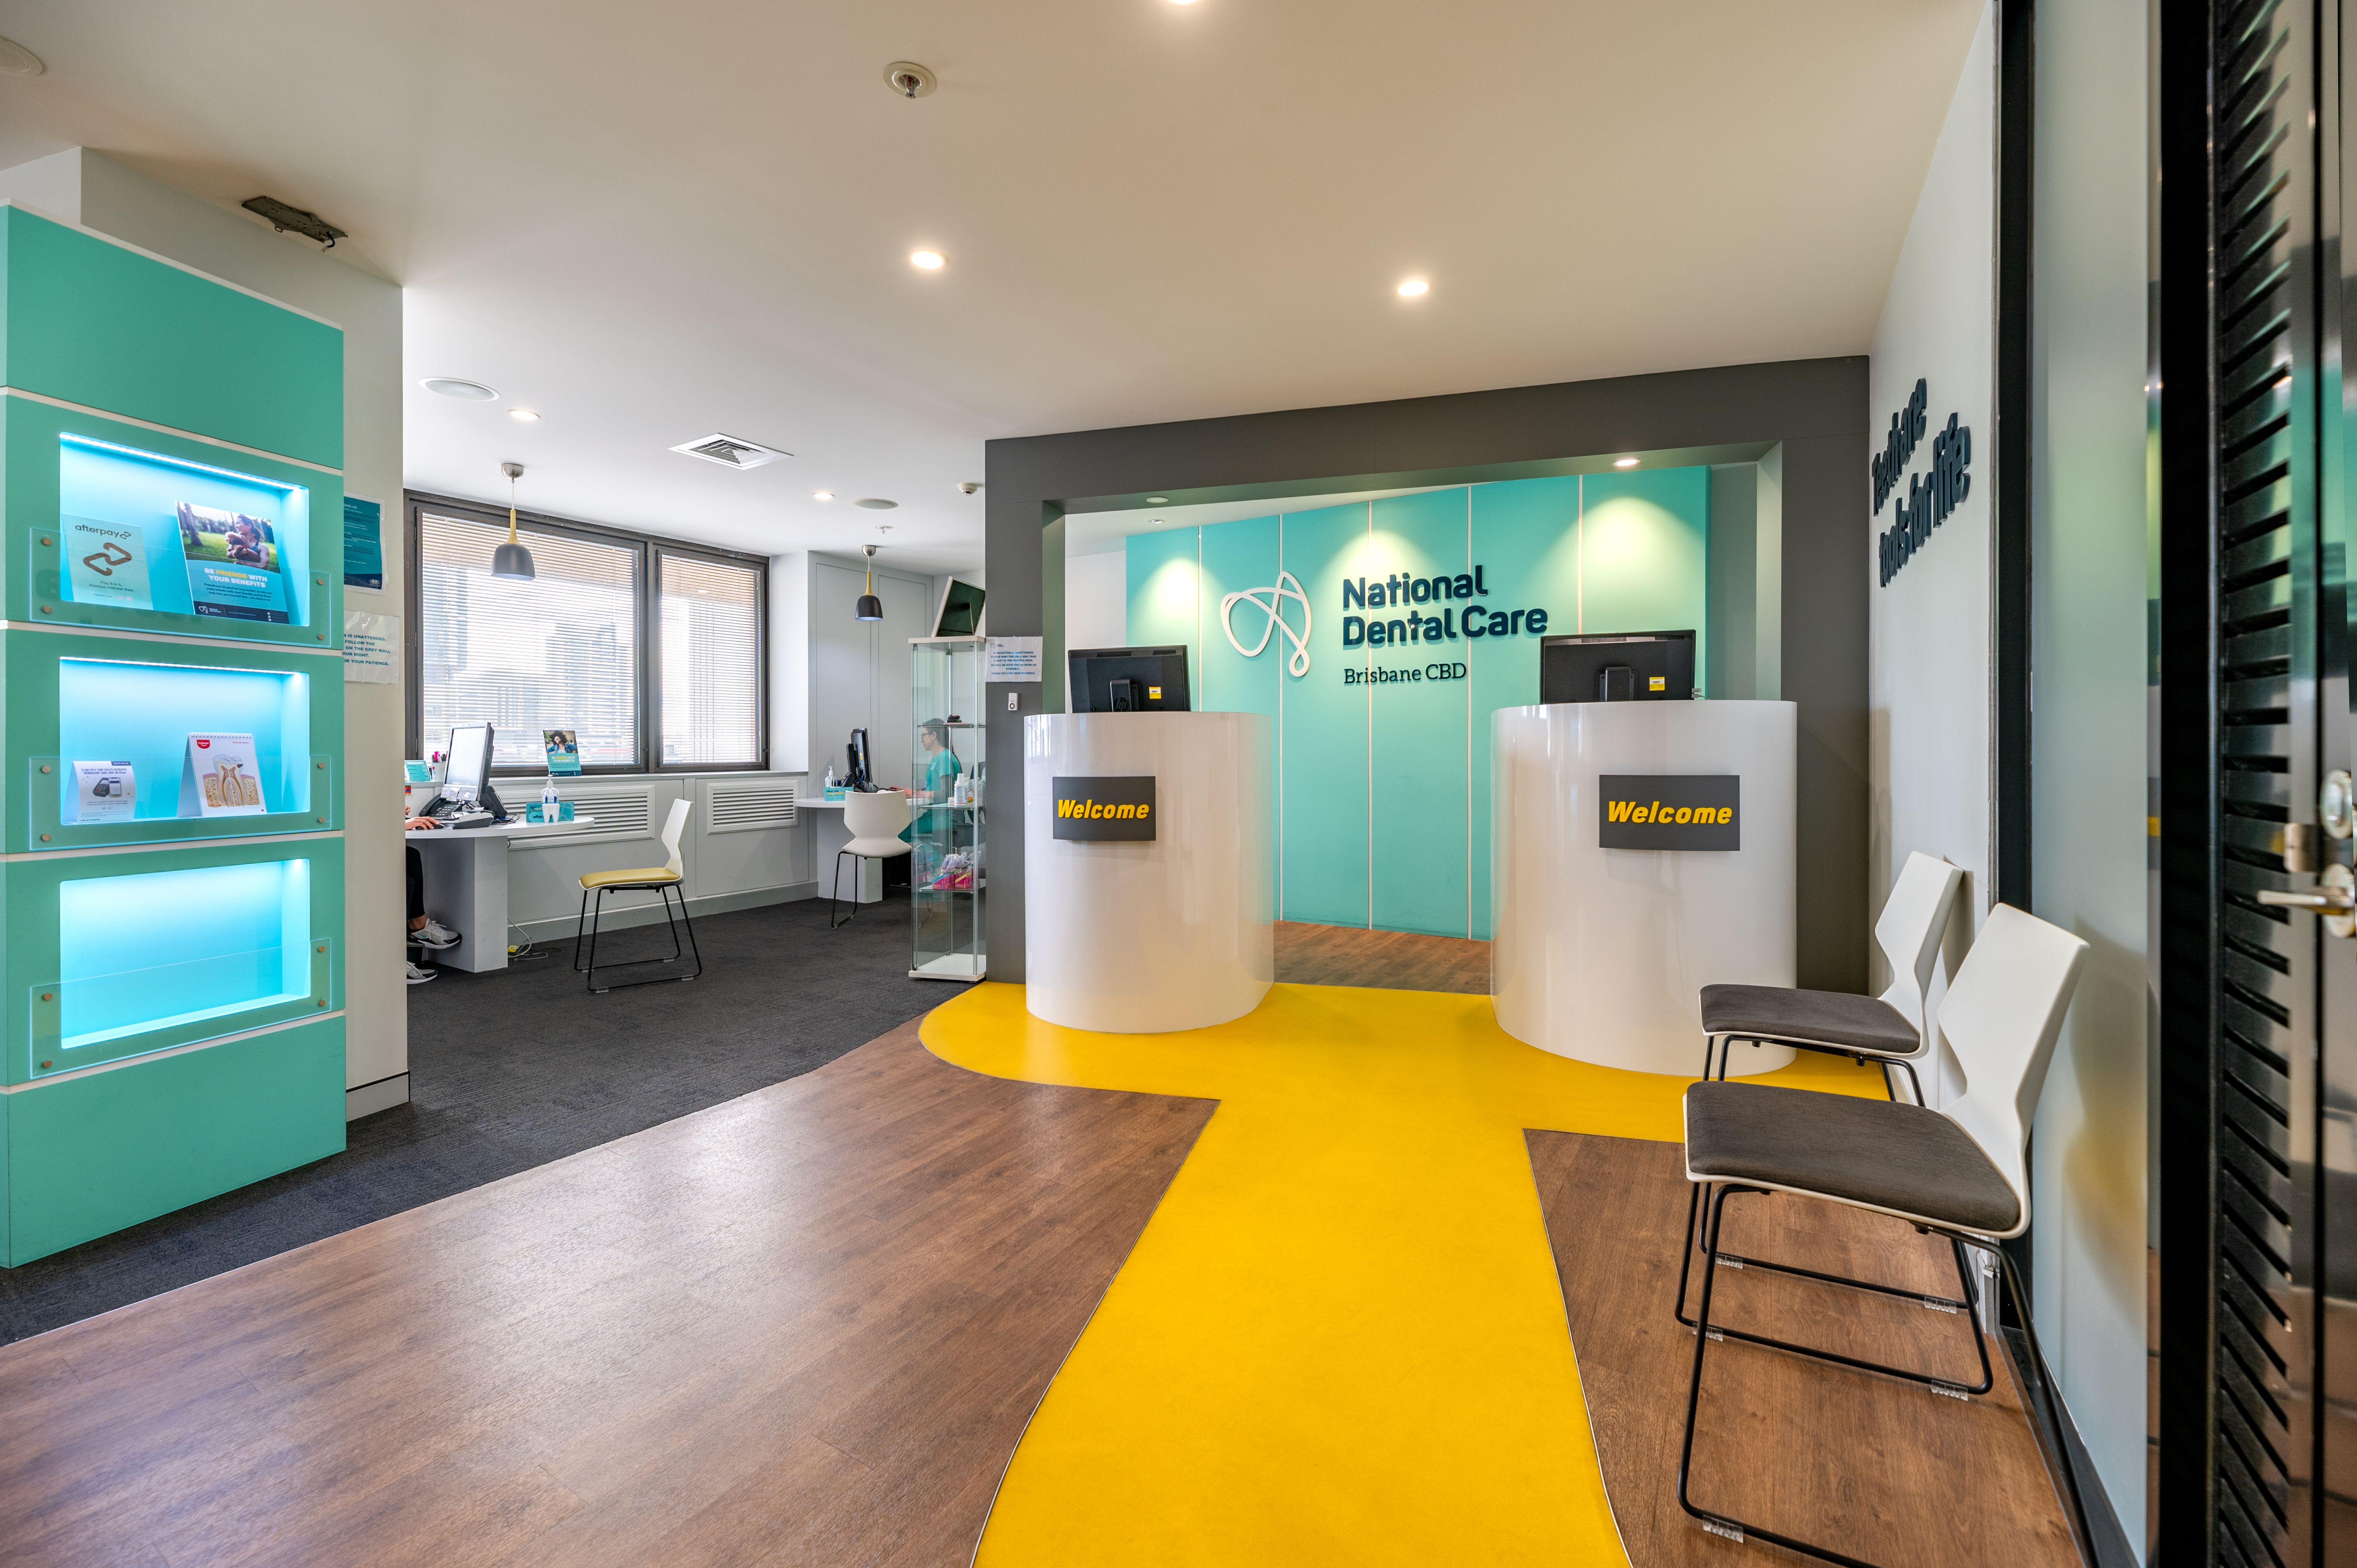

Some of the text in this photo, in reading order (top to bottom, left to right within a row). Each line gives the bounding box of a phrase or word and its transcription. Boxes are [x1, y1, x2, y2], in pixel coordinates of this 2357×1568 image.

[1933, 412, 1971, 528] life
[75, 525, 119, 538] afterpay
[208, 575, 266, 587] YOUR BENEFITS
[1343, 565, 1488, 609] National
[1343, 605, 1548, 646] Dental Care
[1344, 663, 1466, 684] Brisbane CBD
[1058, 799, 1149, 819] Welcome
[1608, 801, 1732, 824] Welcome
